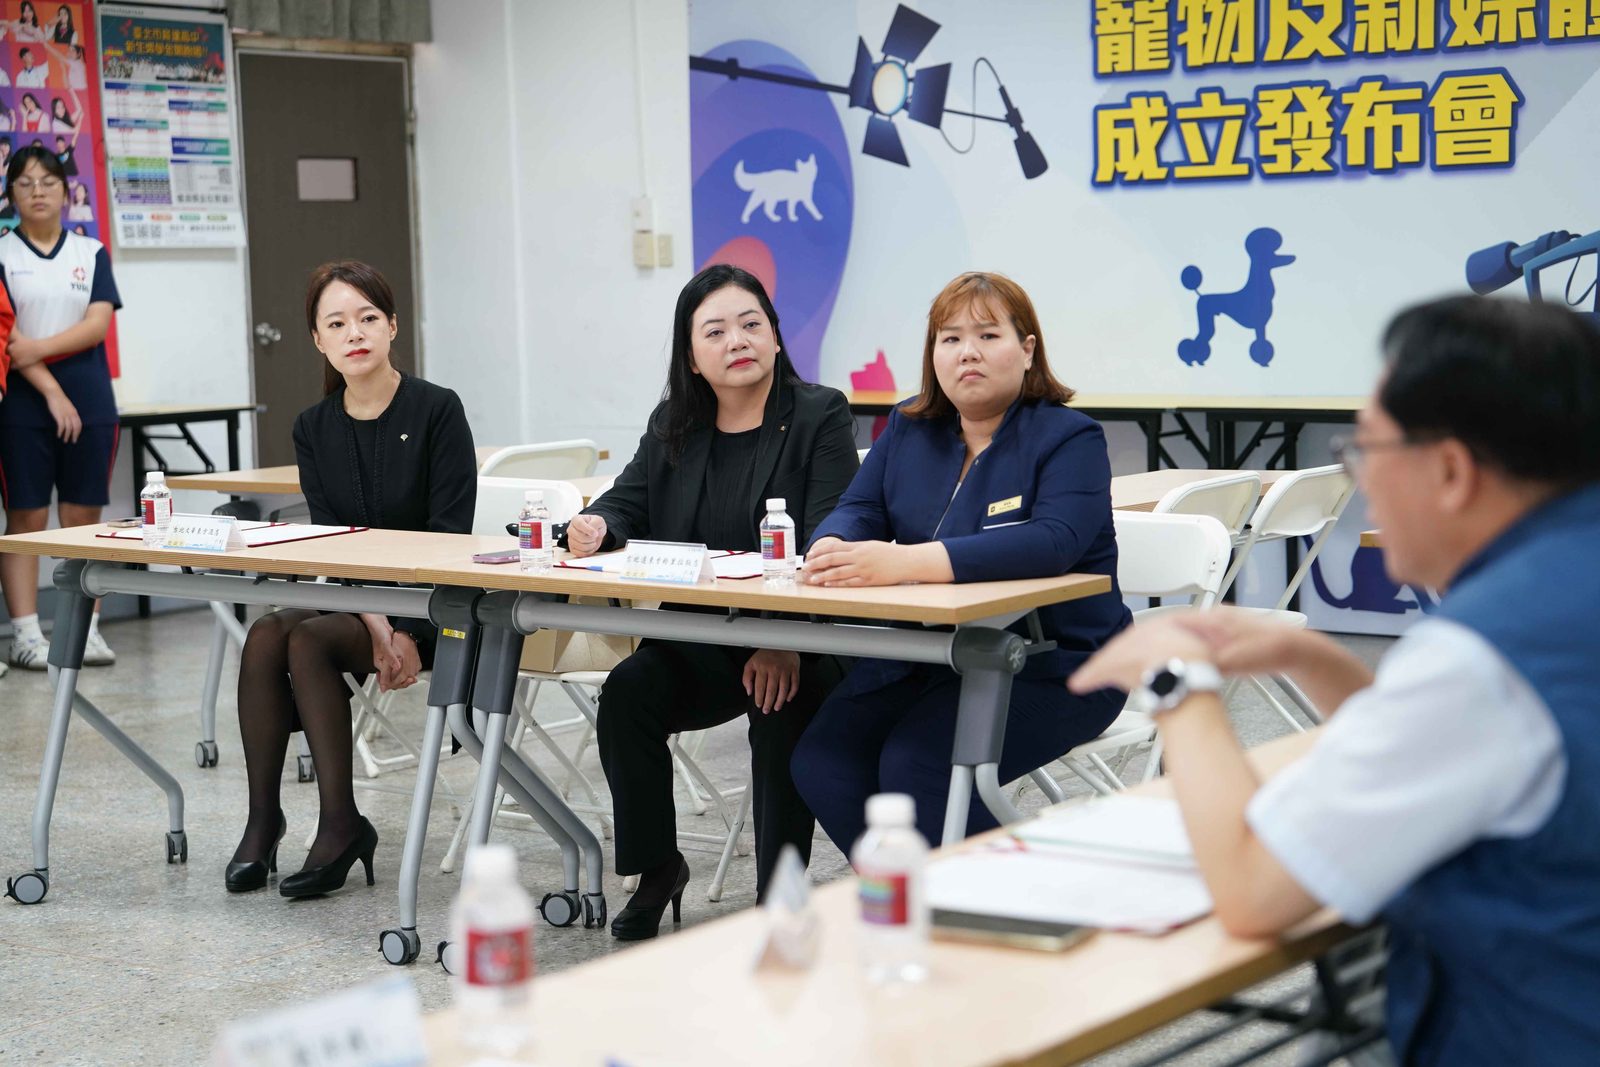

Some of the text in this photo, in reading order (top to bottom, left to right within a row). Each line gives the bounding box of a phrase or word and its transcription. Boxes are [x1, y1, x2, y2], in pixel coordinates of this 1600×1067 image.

[1094, 72, 1520, 183] 成立發布會
